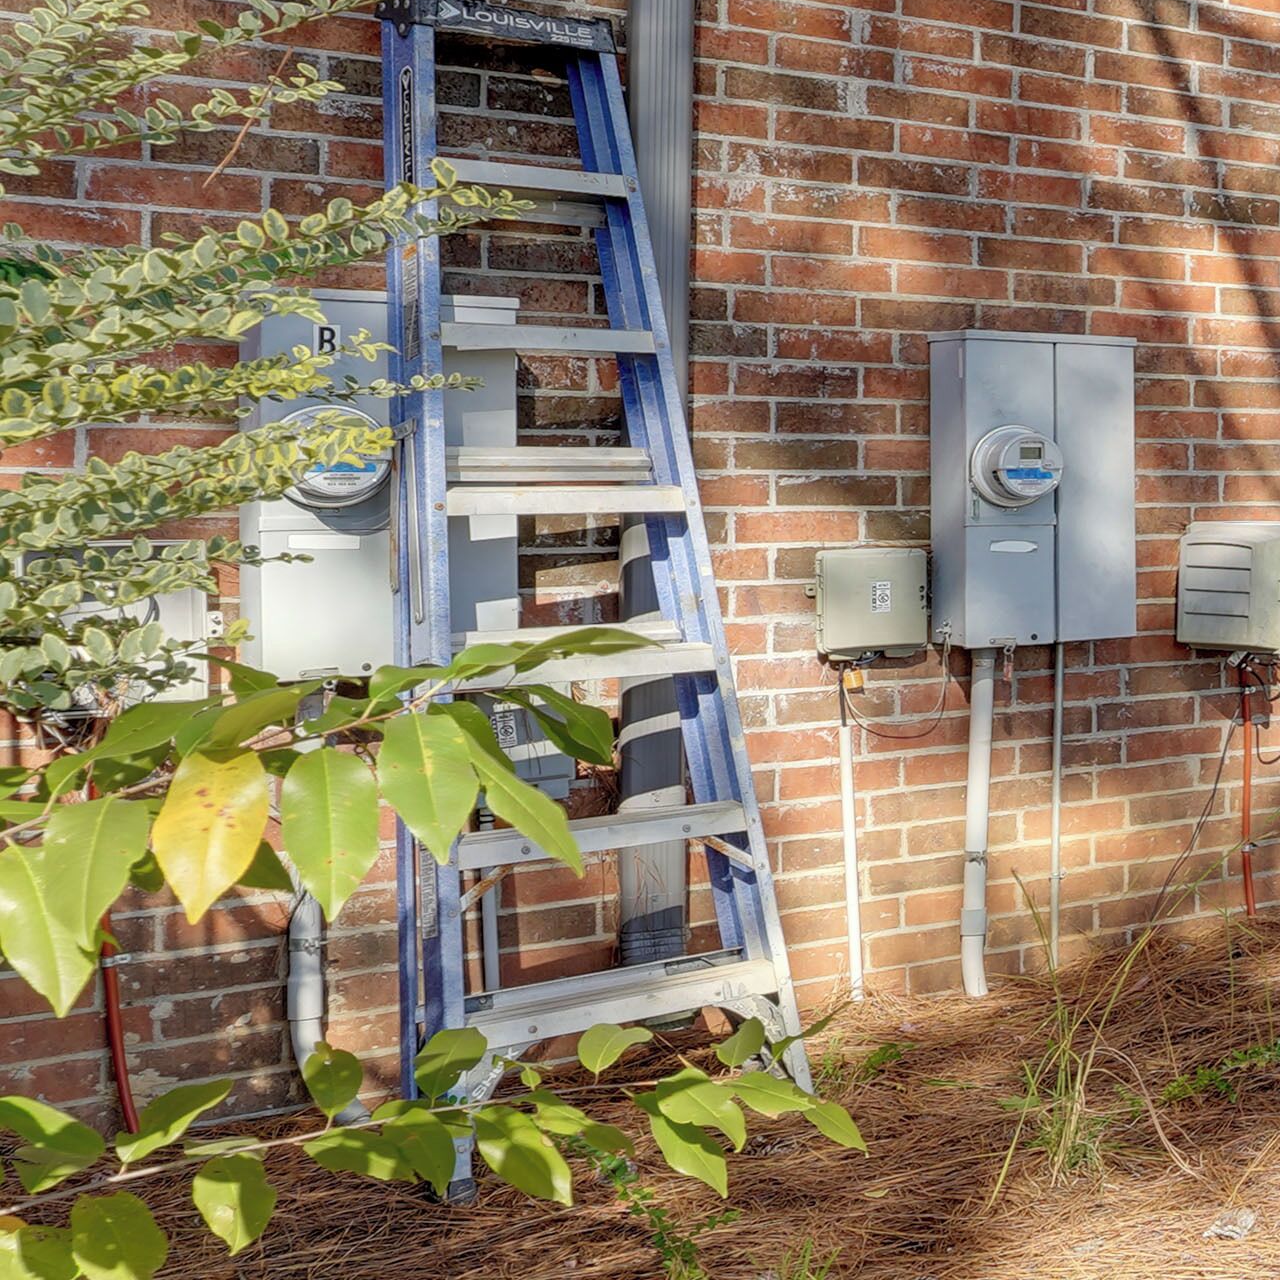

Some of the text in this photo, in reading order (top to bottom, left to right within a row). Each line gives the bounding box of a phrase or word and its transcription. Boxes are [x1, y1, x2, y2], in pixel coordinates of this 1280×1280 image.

[462, 7, 593, 39] LOUISVILLE
[403, 89, 412, 184] LOUISVILL
[318, 326, 336, 355] B
